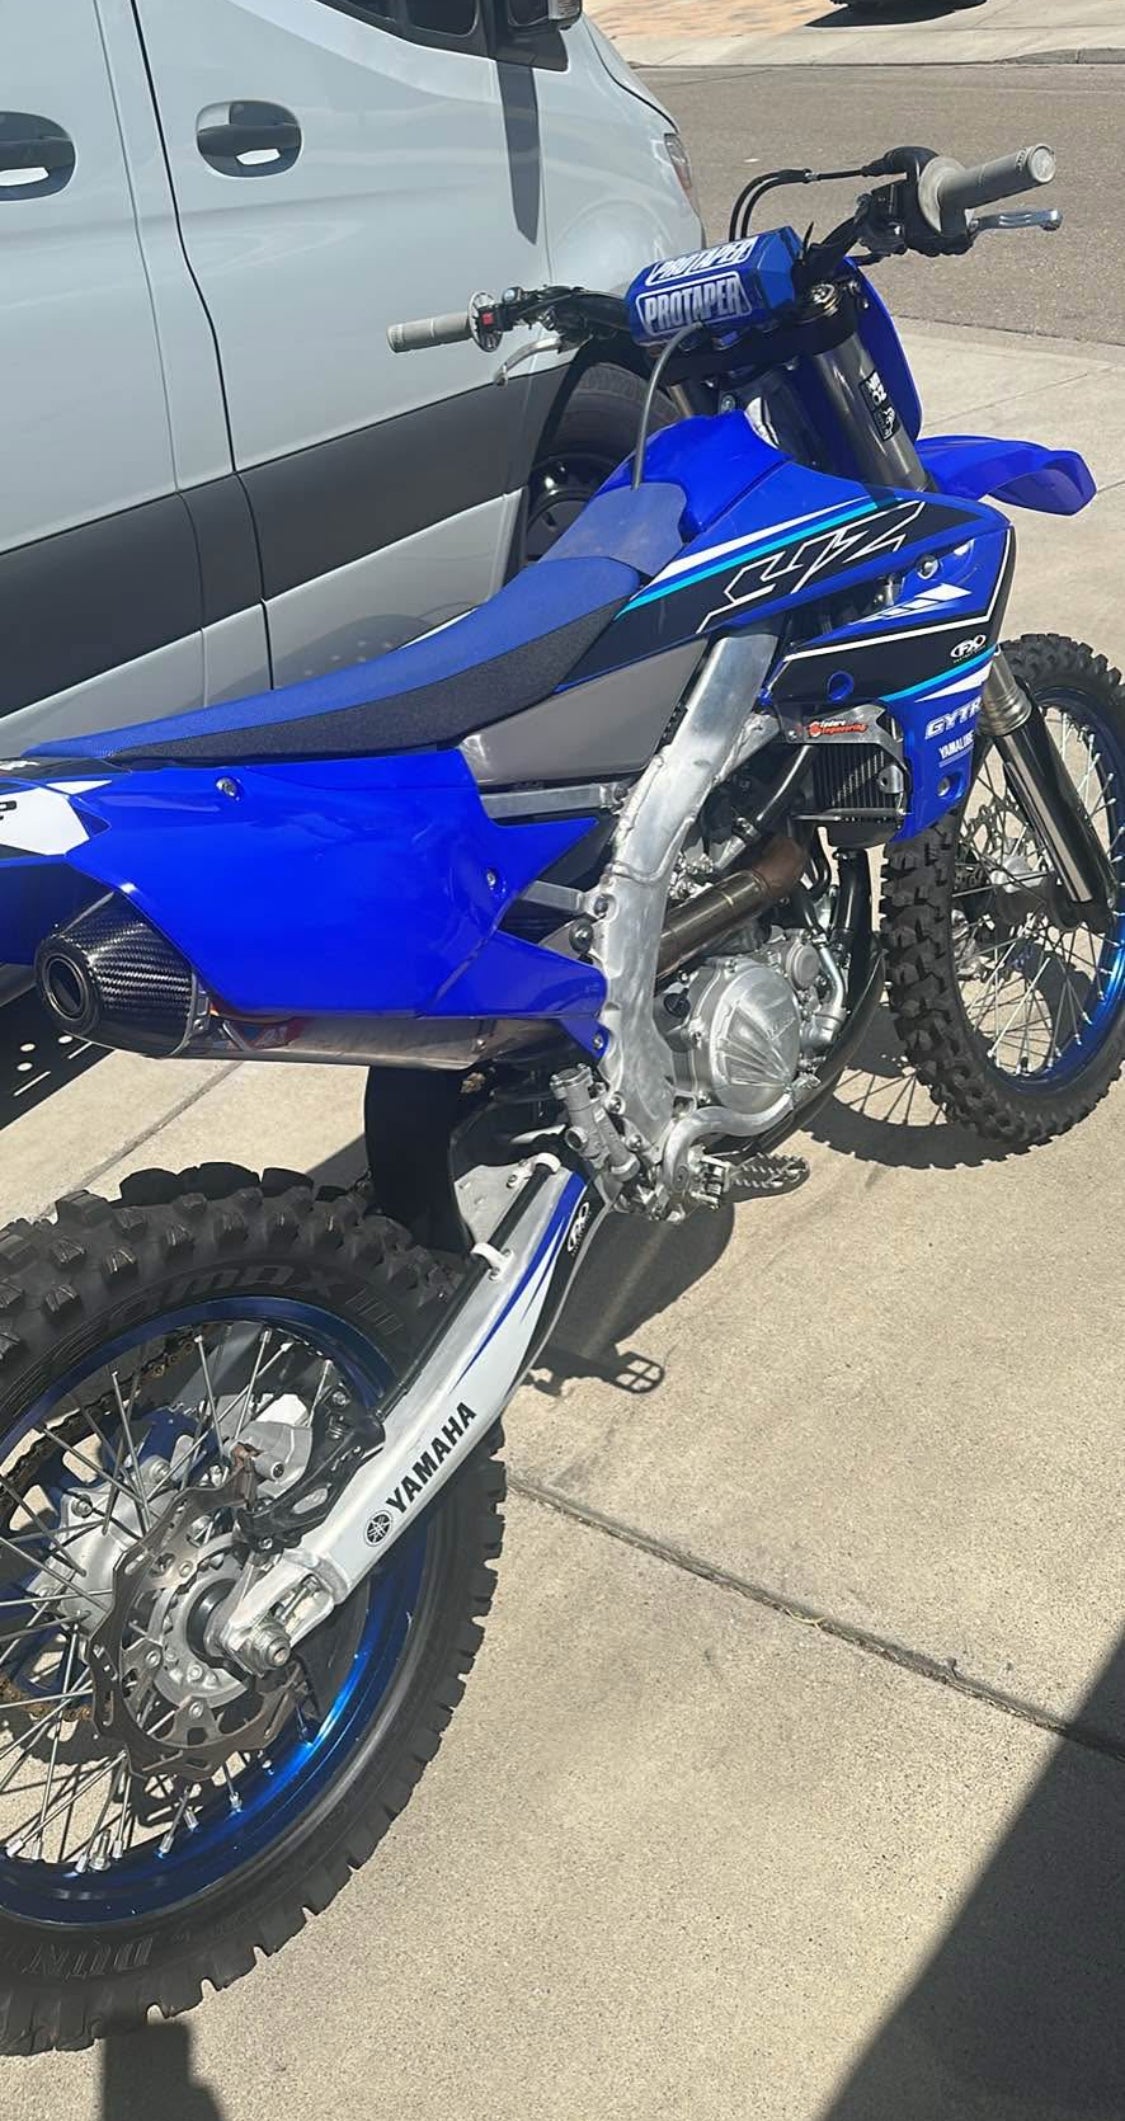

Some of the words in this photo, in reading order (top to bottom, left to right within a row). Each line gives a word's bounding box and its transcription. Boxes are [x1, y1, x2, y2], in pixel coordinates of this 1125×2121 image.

[657, 239, 752, 280] PROTAPER
[645, 278, 742, 331] PROTAPER
[924, 696, 983, 740] GYTR
[385, 1402, 477, 1514] YAMAHA
